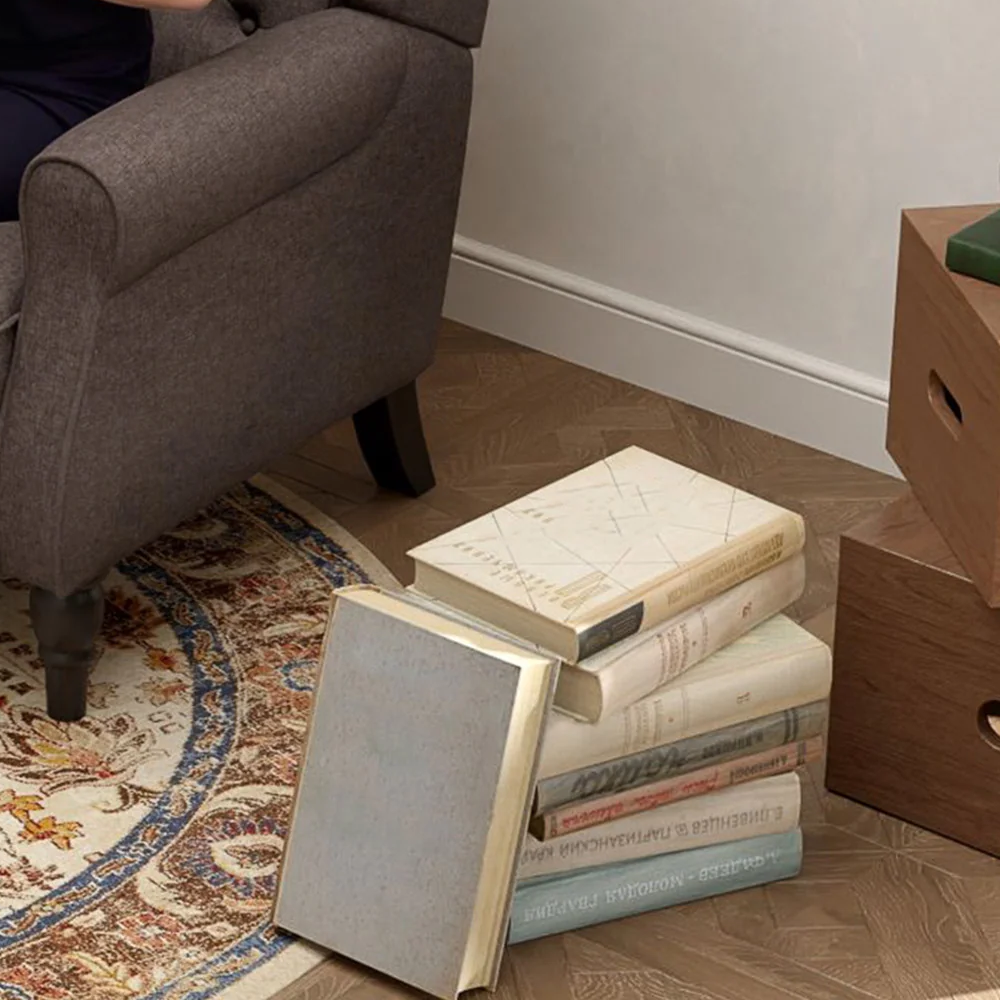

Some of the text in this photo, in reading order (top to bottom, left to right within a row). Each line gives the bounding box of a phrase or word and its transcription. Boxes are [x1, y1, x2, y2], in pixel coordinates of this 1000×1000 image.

[561, 827, 671, 859] ПАРТИЗАНСКИЙ
[605, 874, 686, 904] МОЛОДАЯ
[523, 893, 598, 923] ГВАРДИЯ
